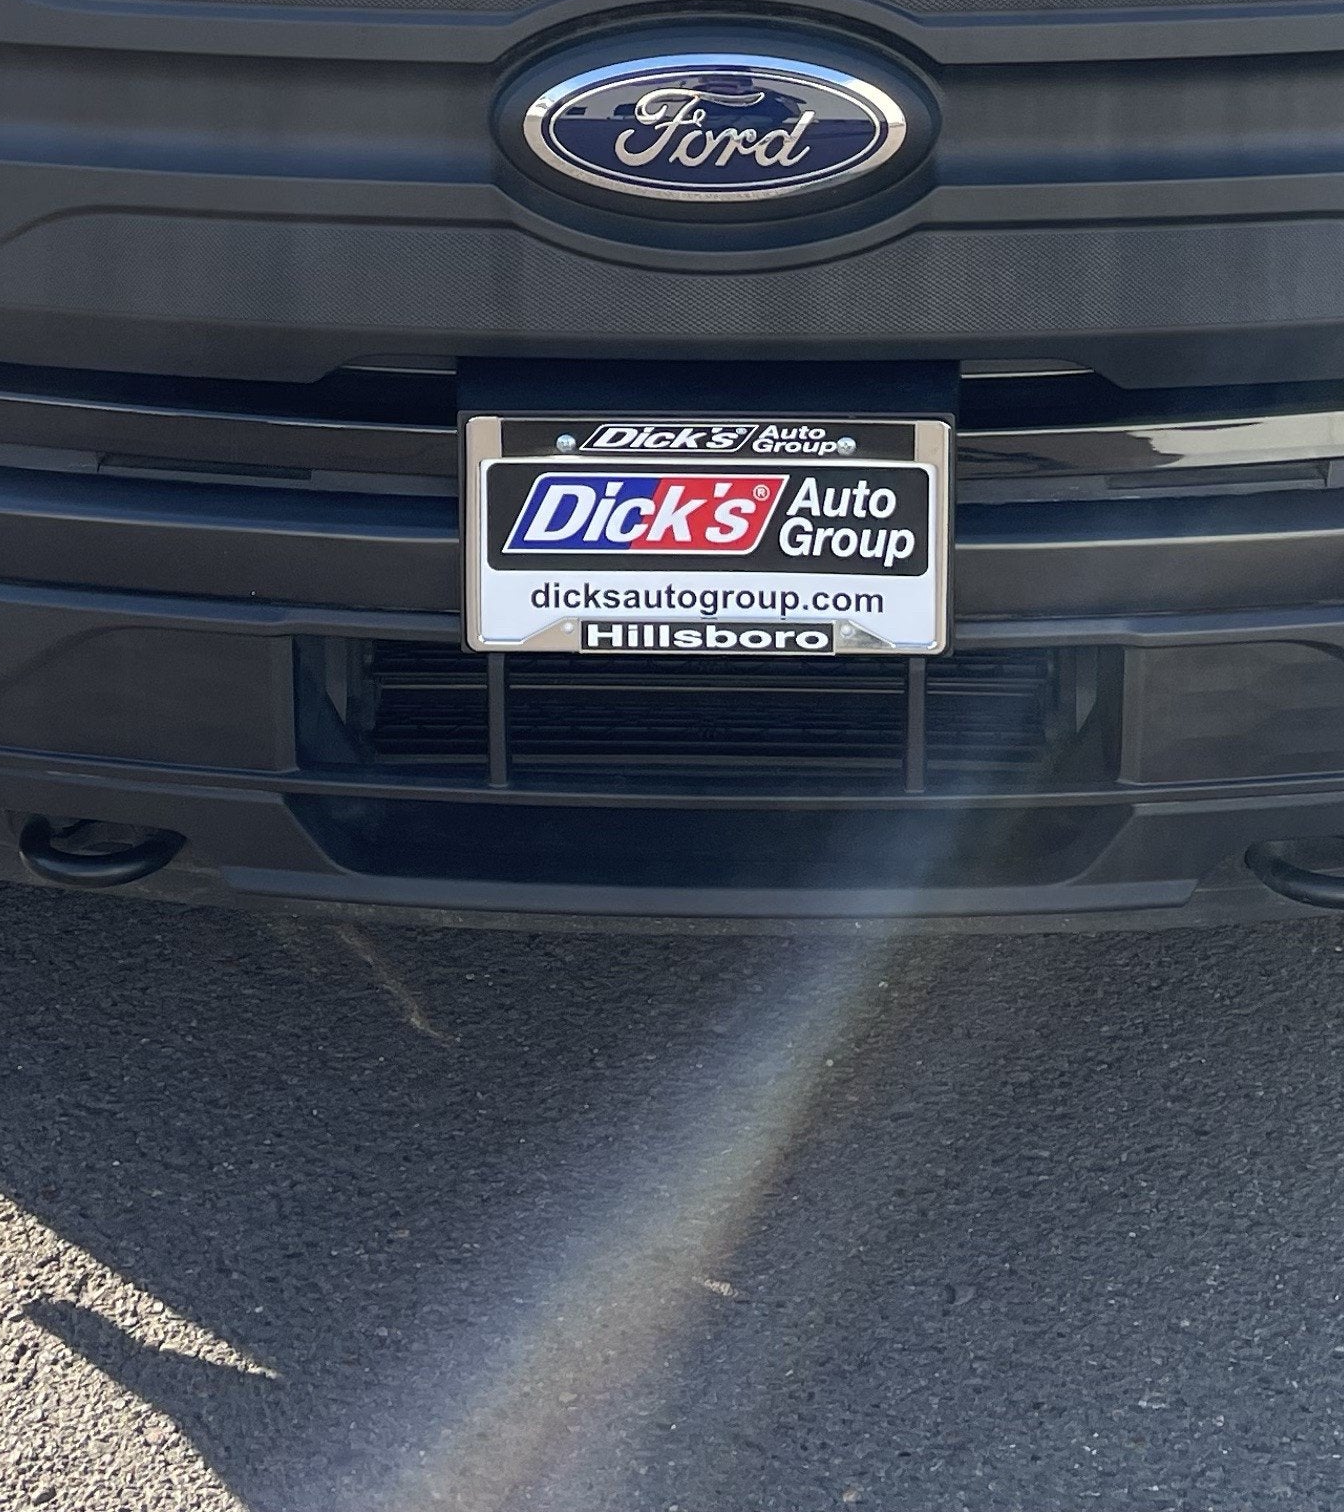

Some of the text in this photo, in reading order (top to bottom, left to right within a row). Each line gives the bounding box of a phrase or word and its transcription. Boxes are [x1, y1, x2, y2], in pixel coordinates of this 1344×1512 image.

[614, 88, 817, 168] Ford
[751, 438, 840, 456] Group
[757, 425, 826, 441] Auto
[786, 477, 897, 519] Auto
[779, 520, 915, 568] Group
[530, 582, 885, 620] dicksautogroup.com
[585, 623, 829, 650] Hillsboro
